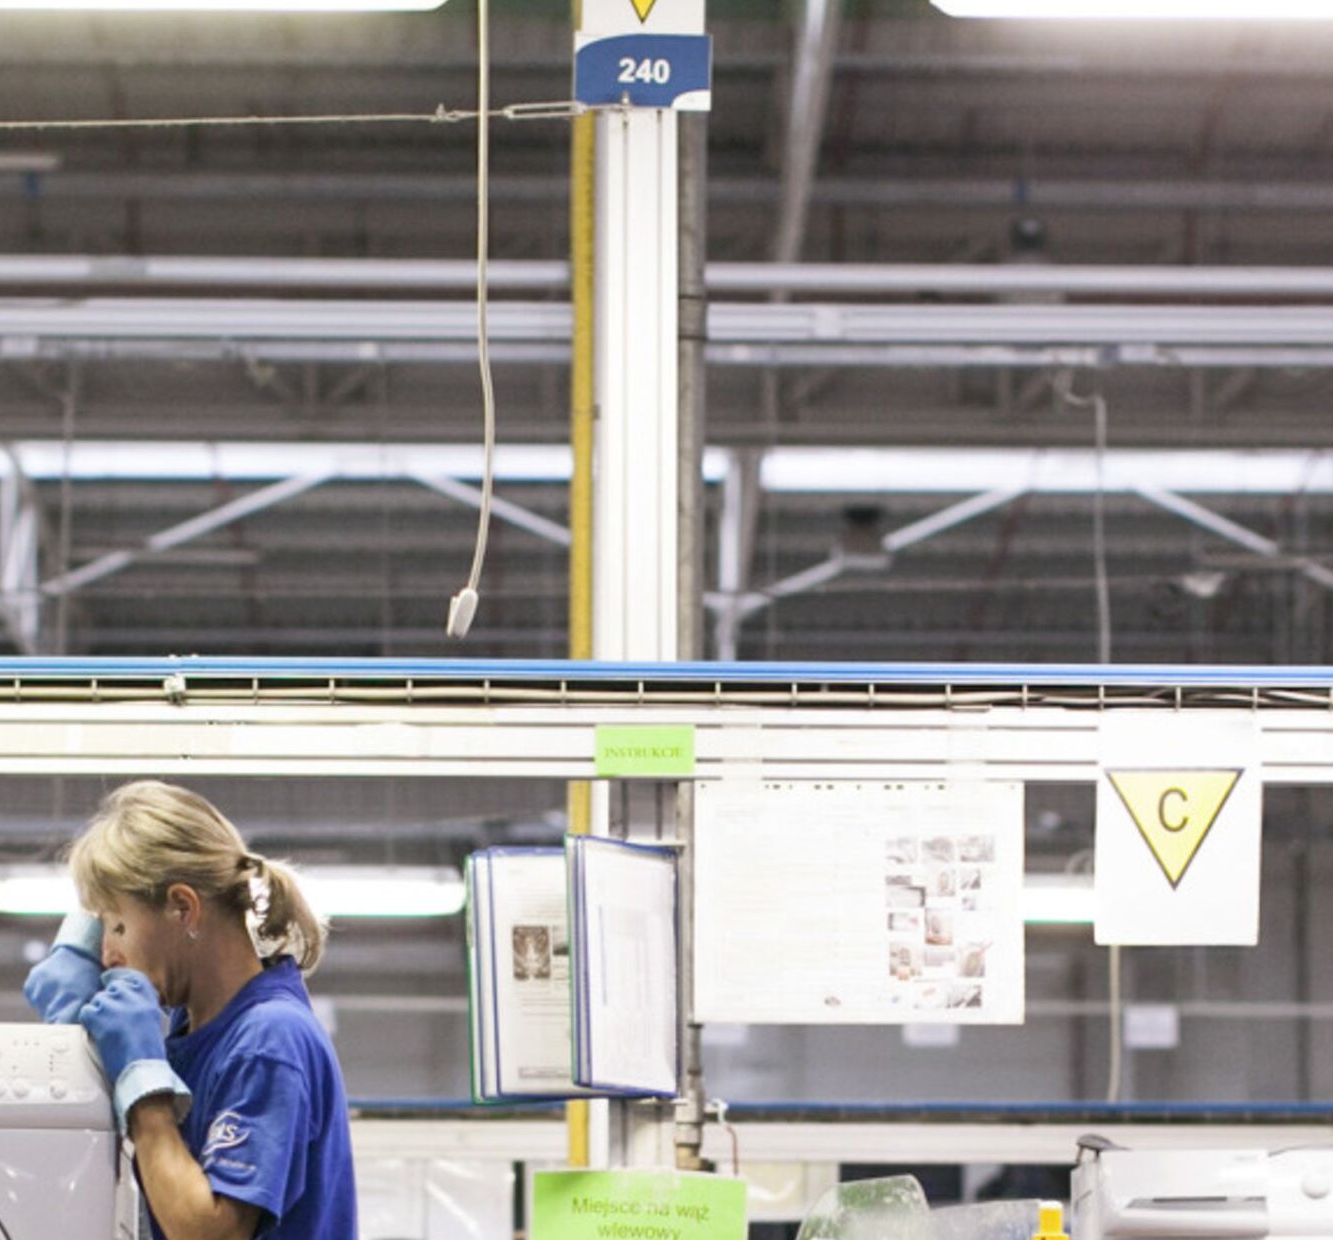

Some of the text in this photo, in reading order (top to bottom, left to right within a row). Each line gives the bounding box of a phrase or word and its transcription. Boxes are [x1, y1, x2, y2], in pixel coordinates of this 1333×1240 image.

[618, 57, 671, 84] 240
[604, 745, 683, 759] INSTRUKCJE
[1158, 787, 1189, 833] C
[571, 1198, 641, 1218] Miejsce
[647, 1202, 671, 1217] na
